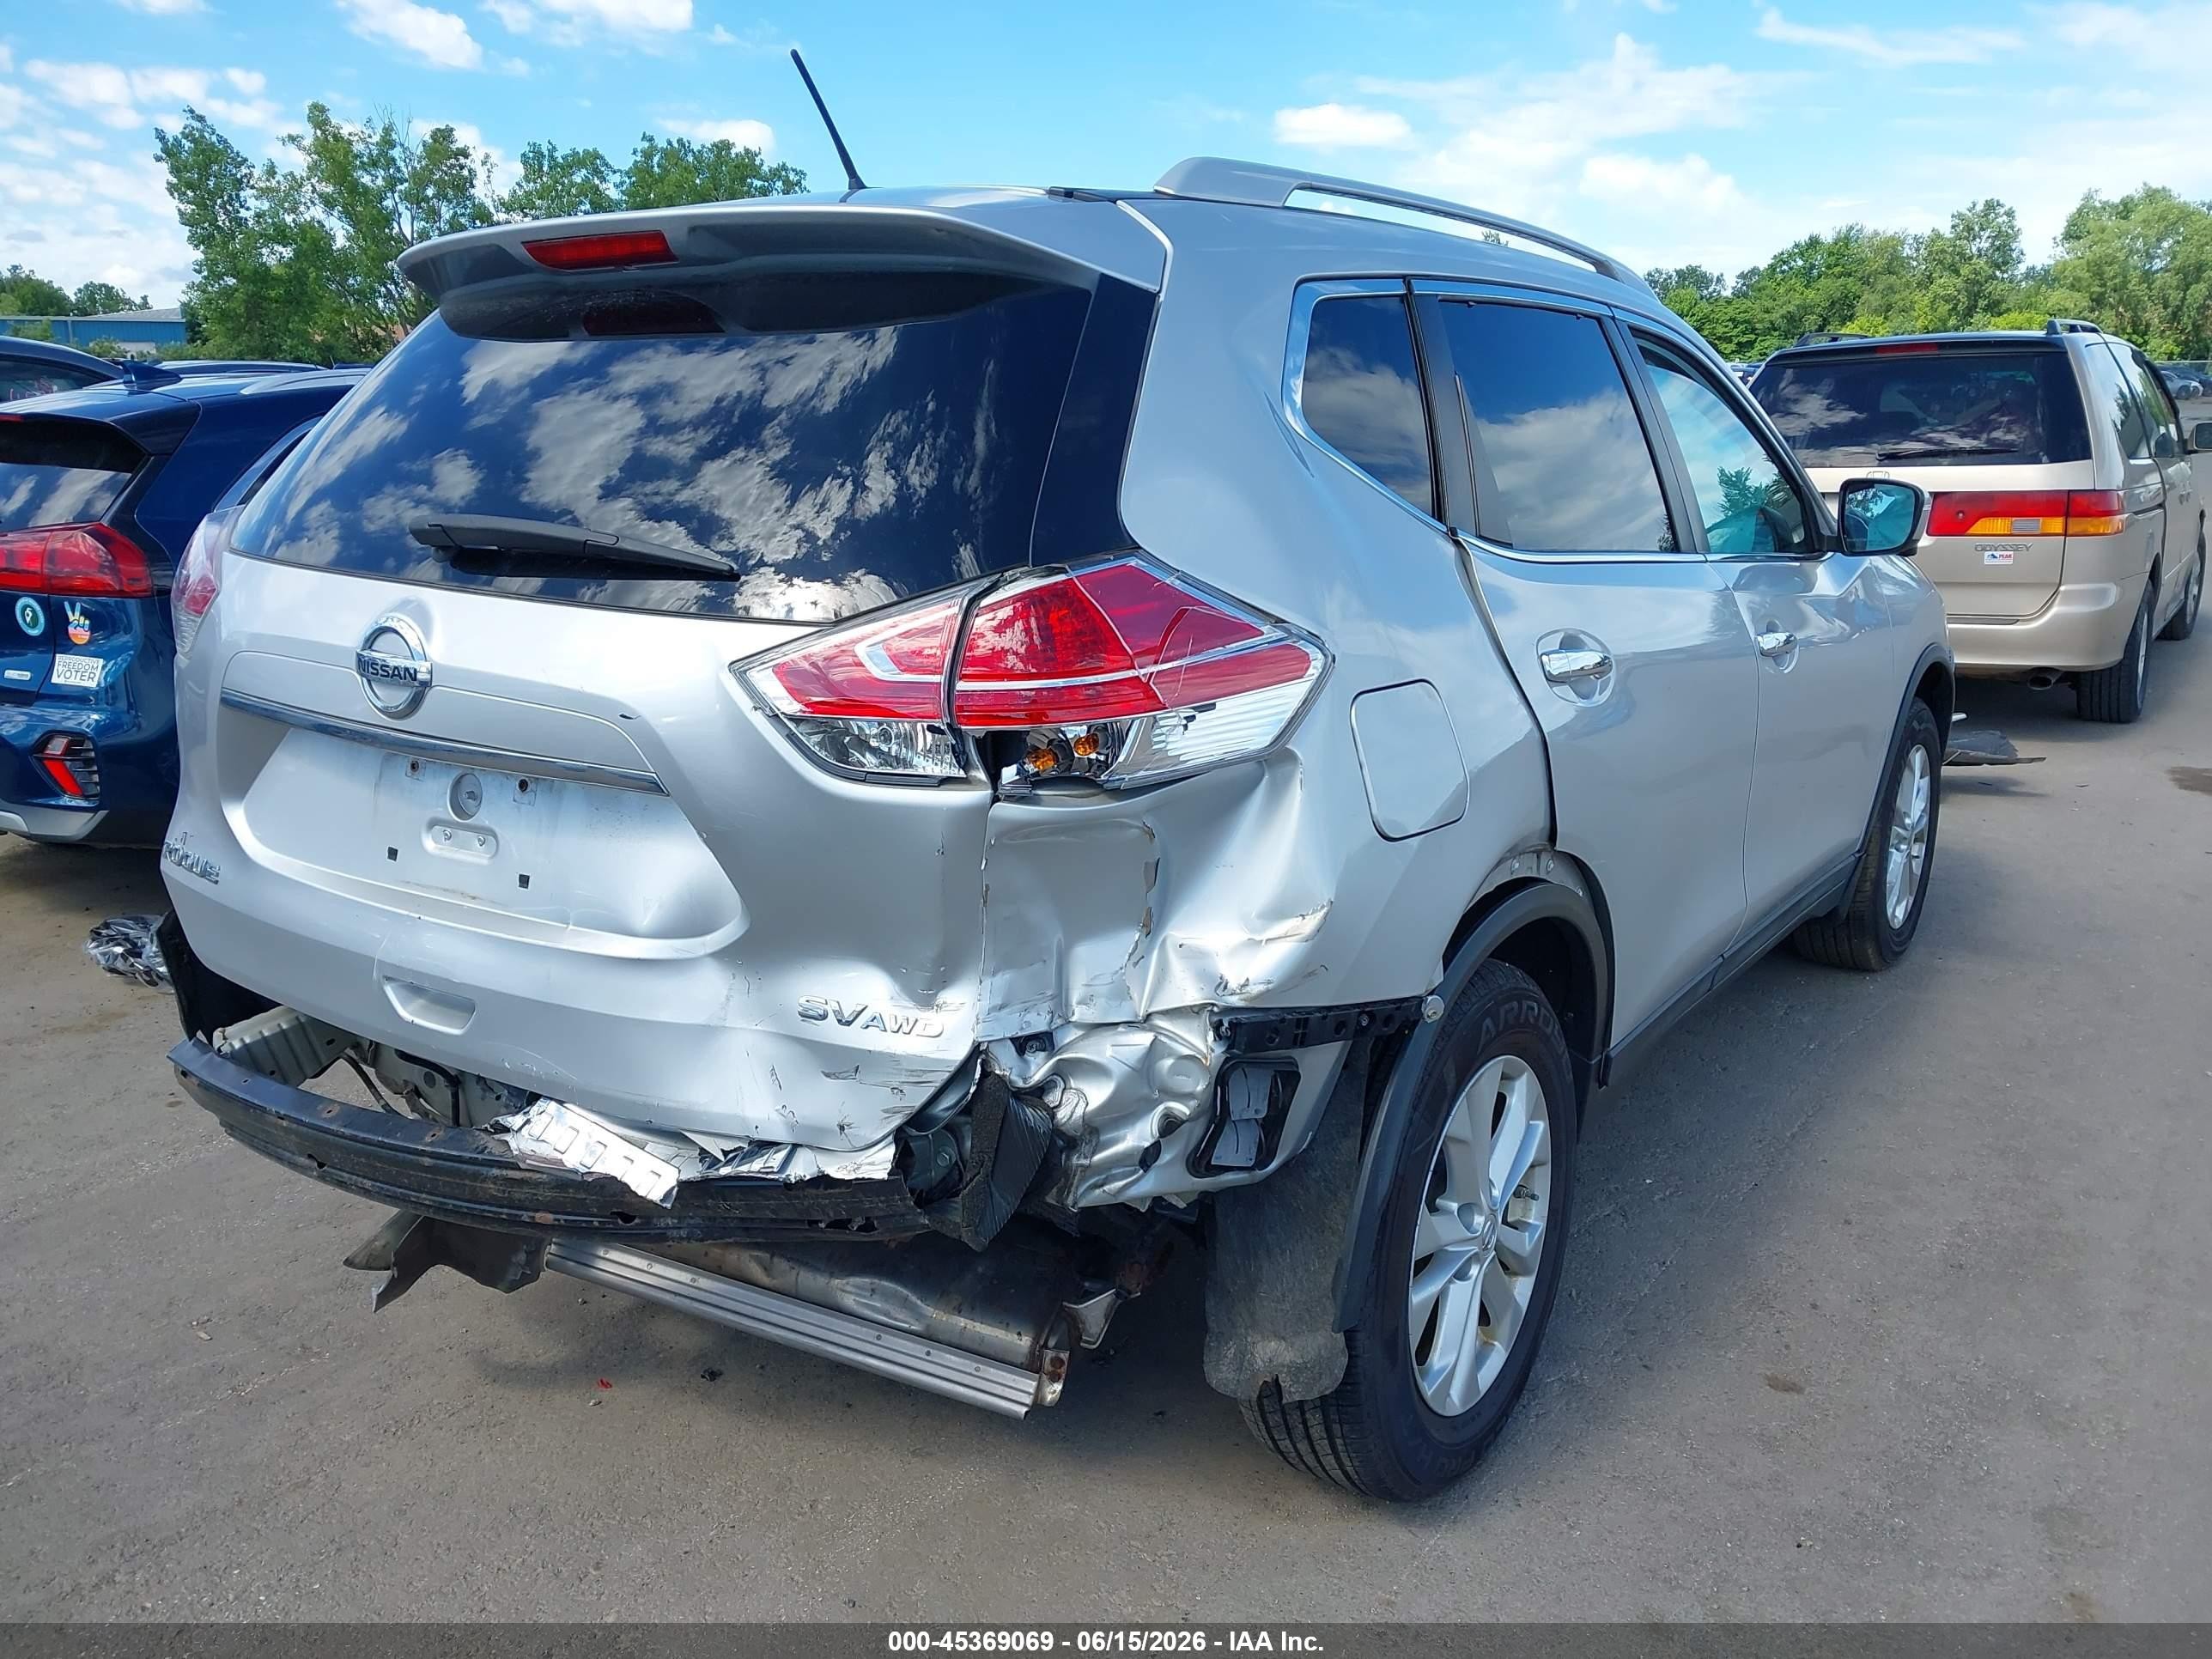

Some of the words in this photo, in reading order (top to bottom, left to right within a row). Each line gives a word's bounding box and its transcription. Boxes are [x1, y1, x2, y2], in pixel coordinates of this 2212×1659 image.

[1975, 543, 2033, 551] ODYSSEY
[58, 661, 99, 672] FREEDOM
[357, 656, 418, 682] NISSAN
[57, 669, 96, 682] VOTER
